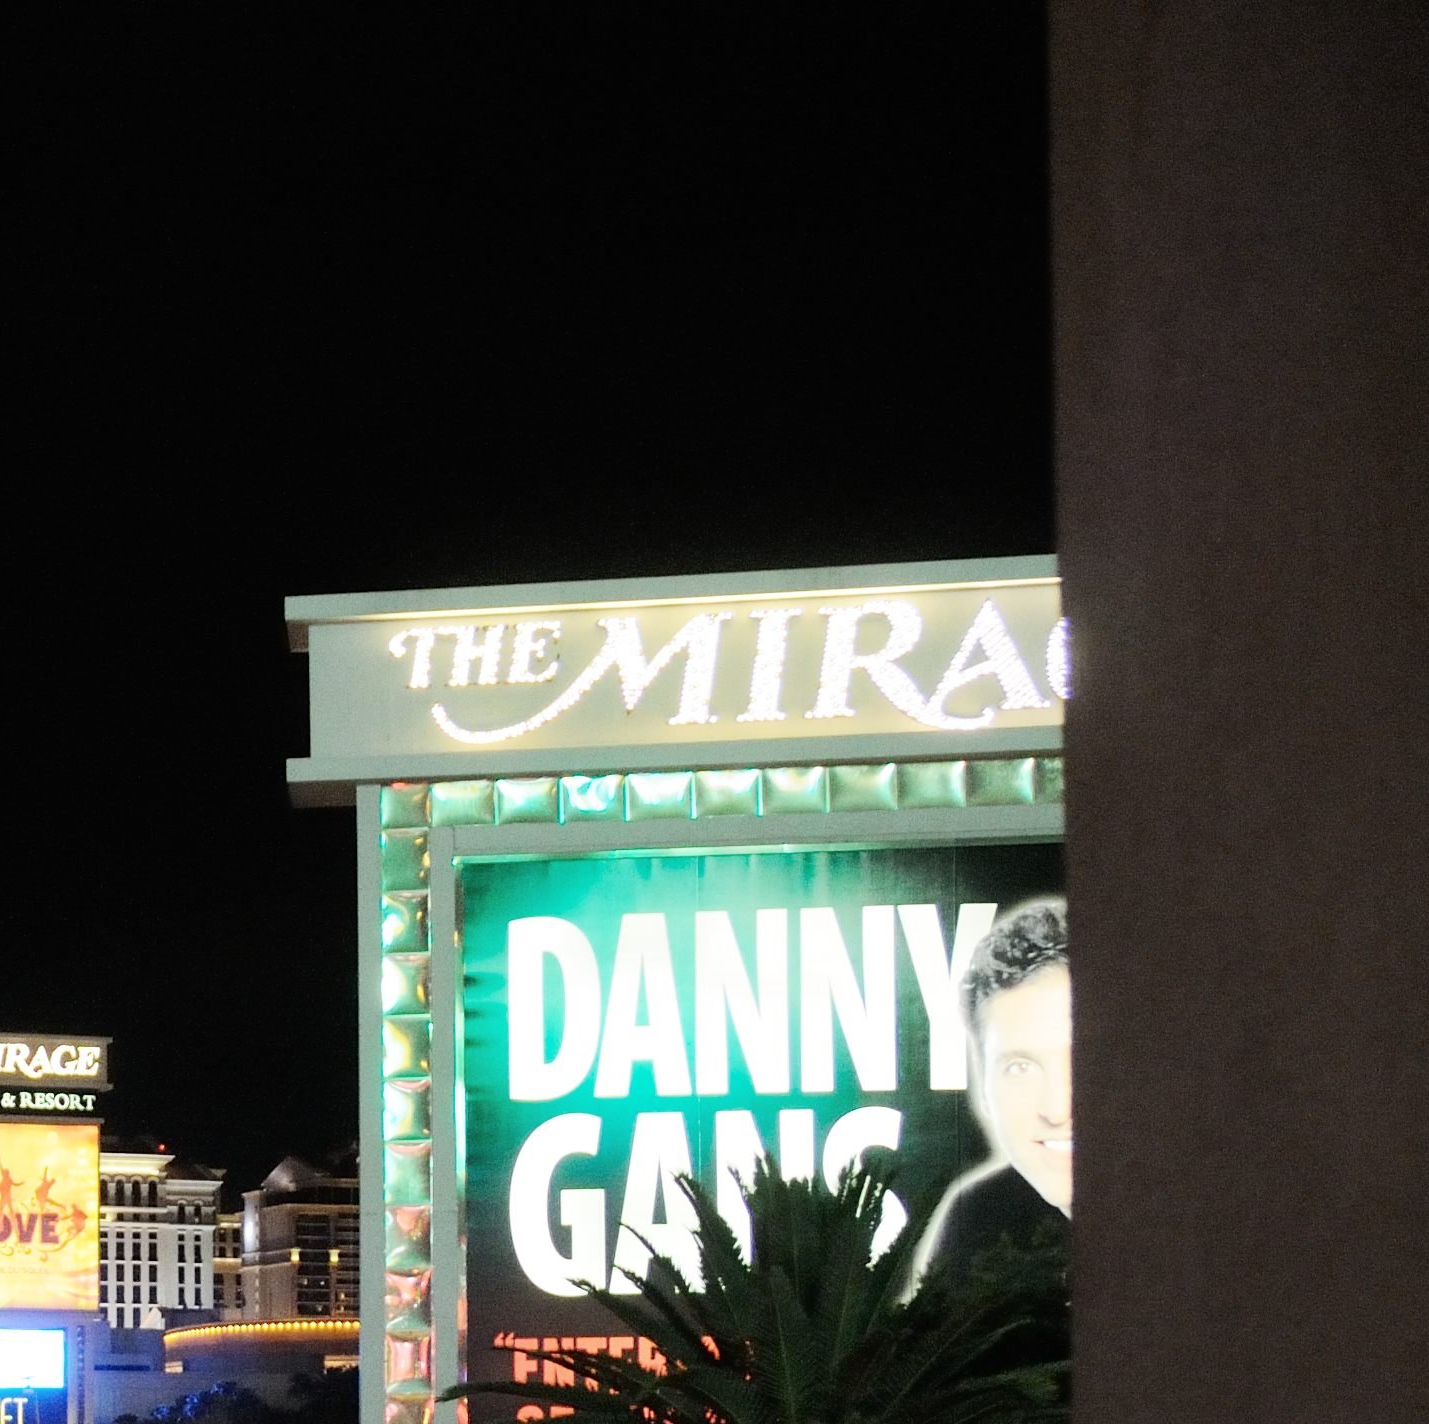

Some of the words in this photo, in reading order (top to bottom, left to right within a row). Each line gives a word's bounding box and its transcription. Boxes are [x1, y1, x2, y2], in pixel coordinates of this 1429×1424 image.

[388, 619, 561, 690] THE
[431, 599, 1069, 746] MIRA
[506, 902, 999, 1102] DANNY
[0, 1091, 17, 1109] &
[19, 1091, 97, 1112] RESORT
